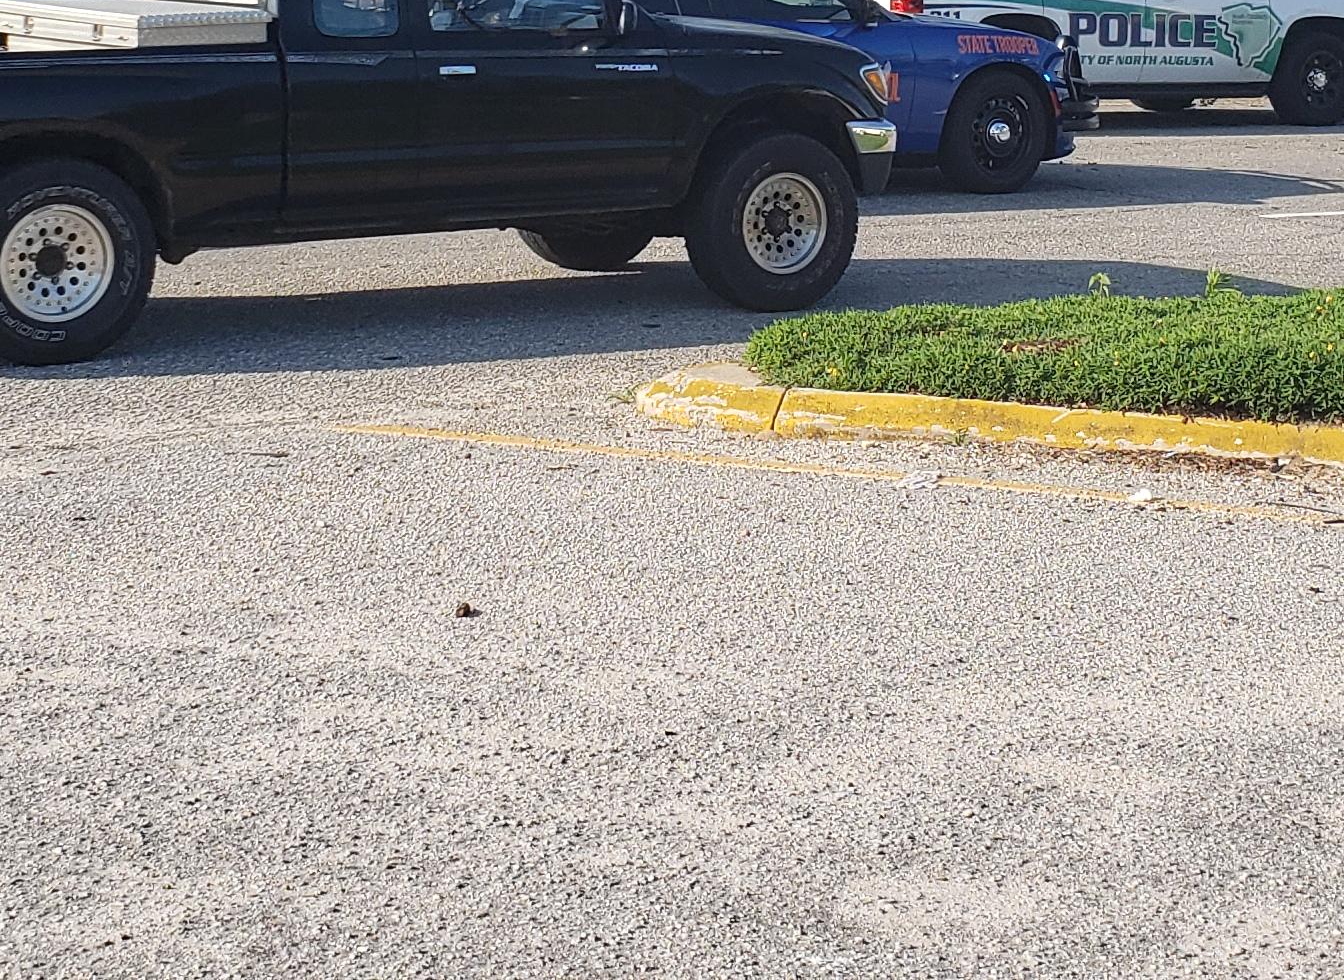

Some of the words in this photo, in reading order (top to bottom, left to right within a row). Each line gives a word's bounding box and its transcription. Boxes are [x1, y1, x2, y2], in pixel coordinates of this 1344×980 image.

[1068, 12, 1219, 49] POLICE
[957, 35, 994, 54] STATE
[990, 35, 1041, 56] TROOPER
[1080, 54, 1096, 65] TY
[1097, 55, 1115, 65] OF
[1116, 55, 1158, 66] NORTH
[1159, 55, 1215, 67] AUGUSTA
